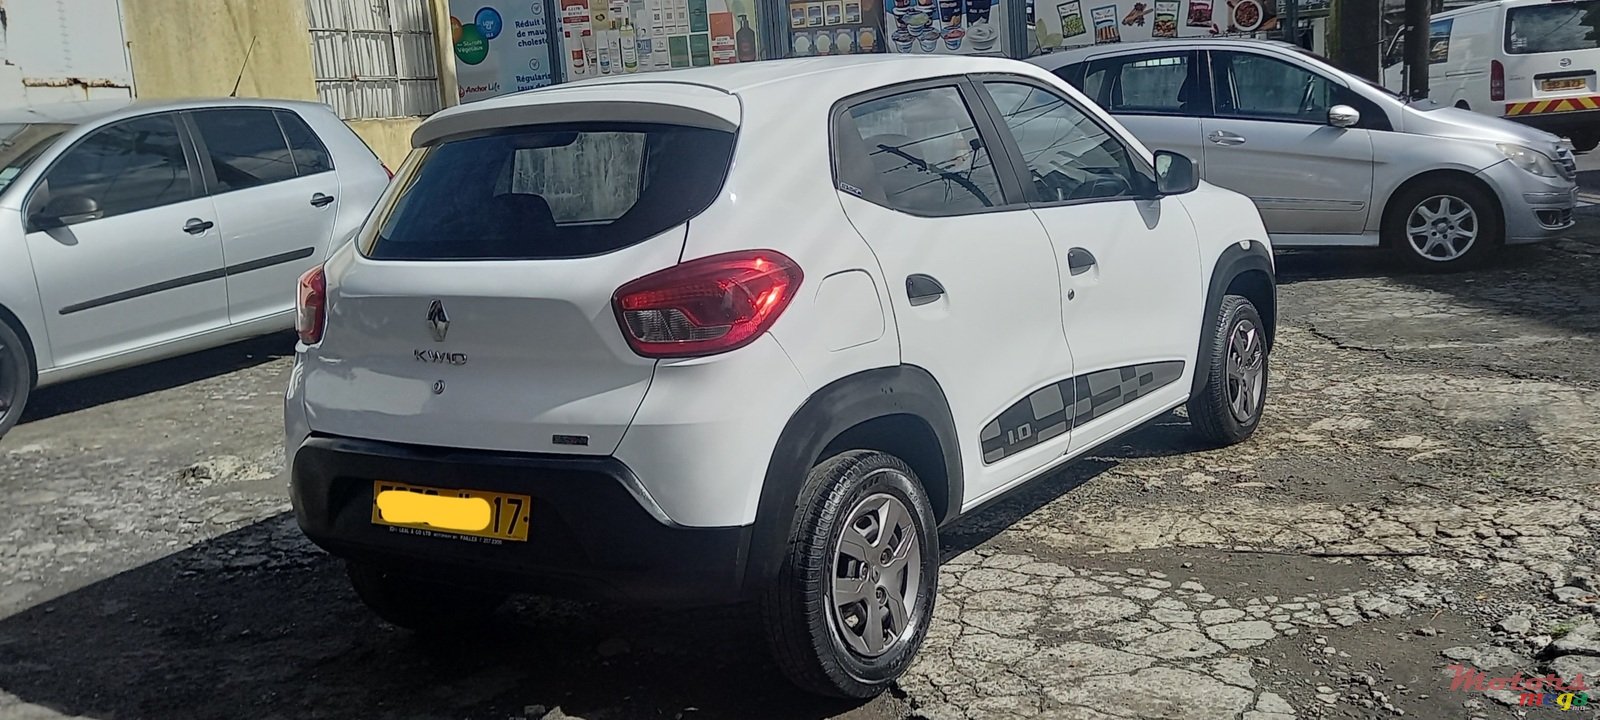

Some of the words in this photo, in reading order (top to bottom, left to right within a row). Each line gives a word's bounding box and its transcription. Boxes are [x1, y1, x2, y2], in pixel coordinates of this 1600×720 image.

[515, 18, 540, 28] Réduit
[517, 30, 526, 38] de
[516, 72, 552, 84] Régularis
[466, 85, 487, 93] Anchor
[488, 82, 500, 92] Life
[413, 348, 468, 366] KWID
[1007, 422, 1032, 446] 1.0
[494, 497, 523, 535] 17
